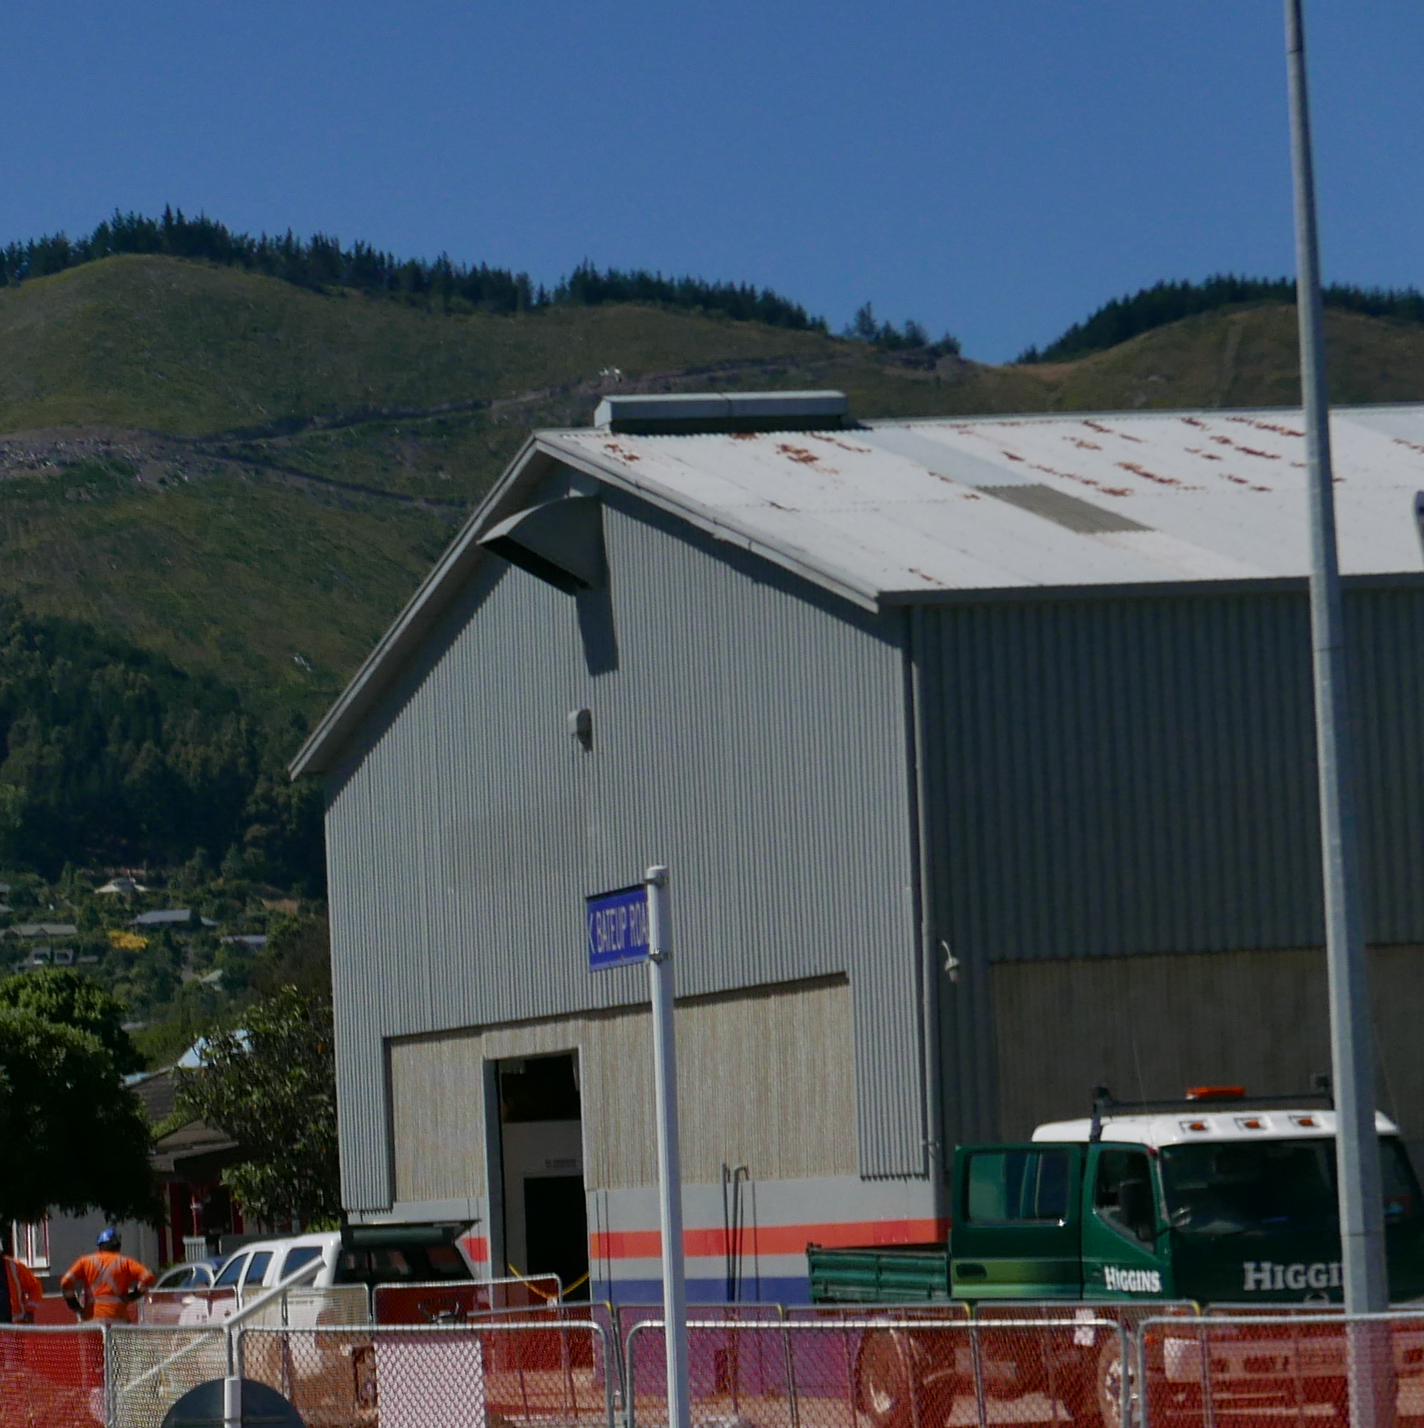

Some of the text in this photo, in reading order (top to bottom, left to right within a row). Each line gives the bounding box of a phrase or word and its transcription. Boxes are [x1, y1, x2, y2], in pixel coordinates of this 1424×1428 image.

[595, 900, 649, 954] BATEUP ROA
[1104, 1265, 1163, 1293] HIGGINS
[1242, 1260, 1343, 1291] HIGGI
